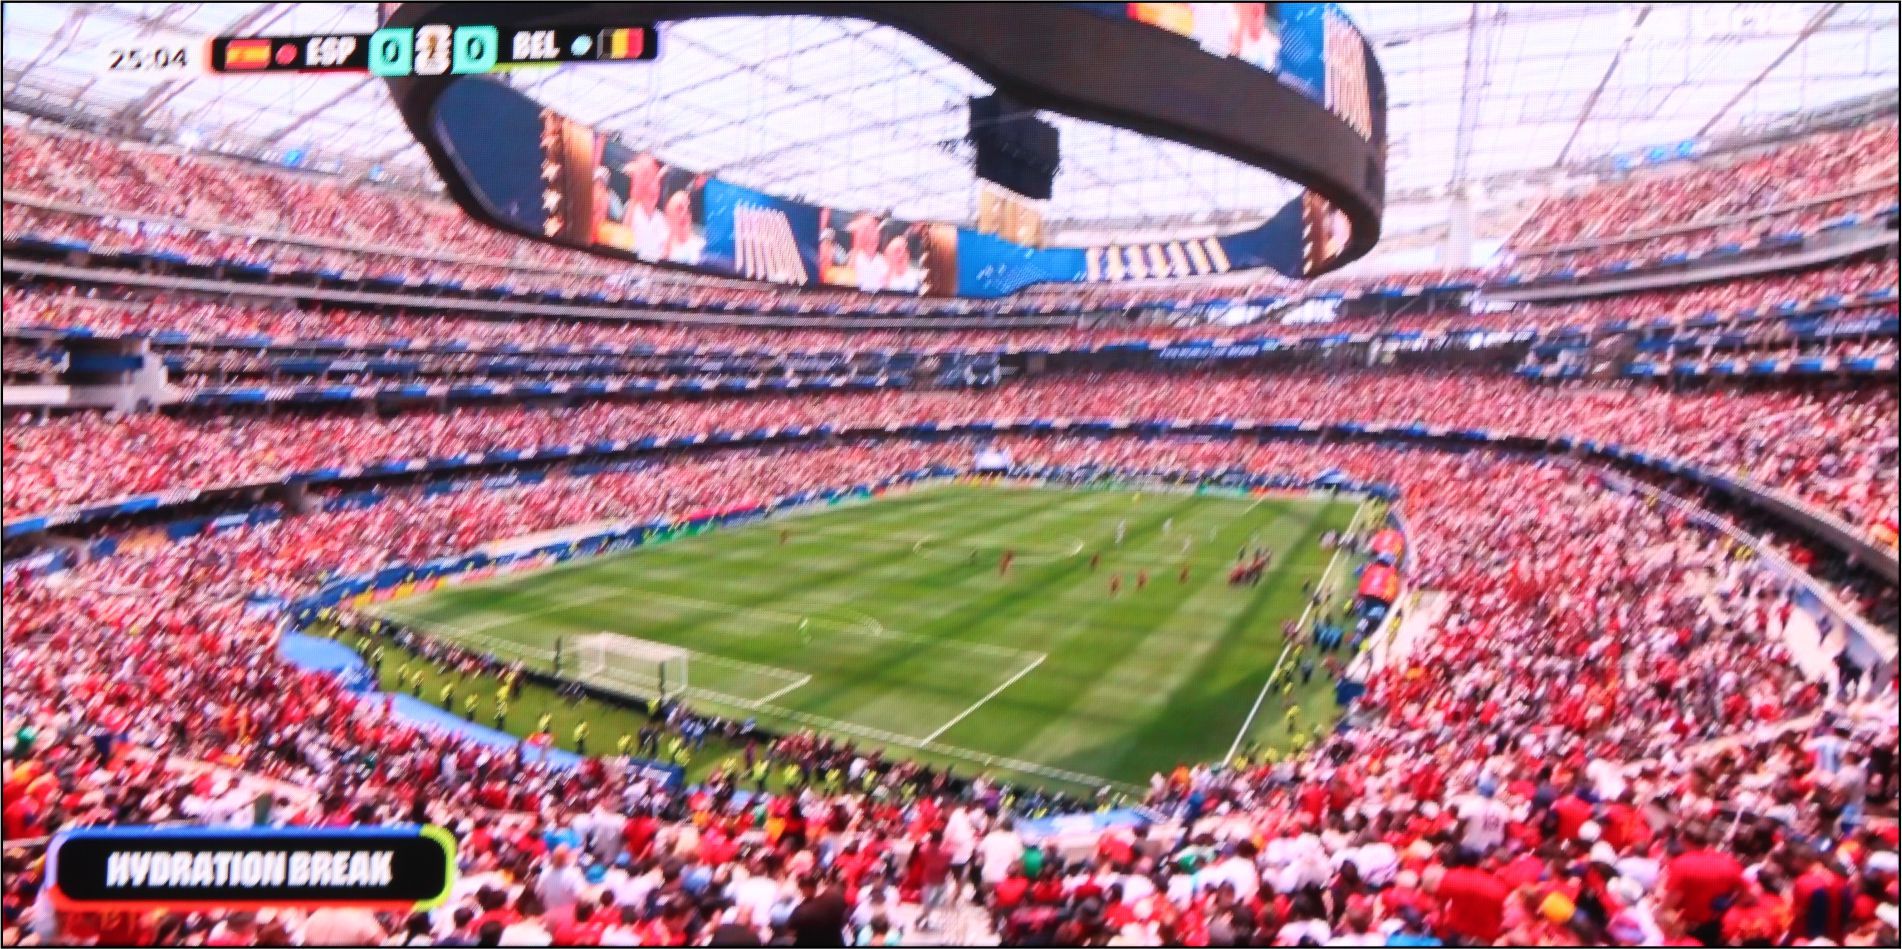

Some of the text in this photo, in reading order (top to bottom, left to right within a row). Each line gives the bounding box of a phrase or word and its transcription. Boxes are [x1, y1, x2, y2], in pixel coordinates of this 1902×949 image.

[108, 47, 187, 71] 25:04
[305, 36, 355, 66] ESP
[382, 37, 399, 63] 0
[467, 35, 483, 62] 0
[512, 30, 560, 60] BEL
[106, 850, 394, 887] HYDRATION BREAK
